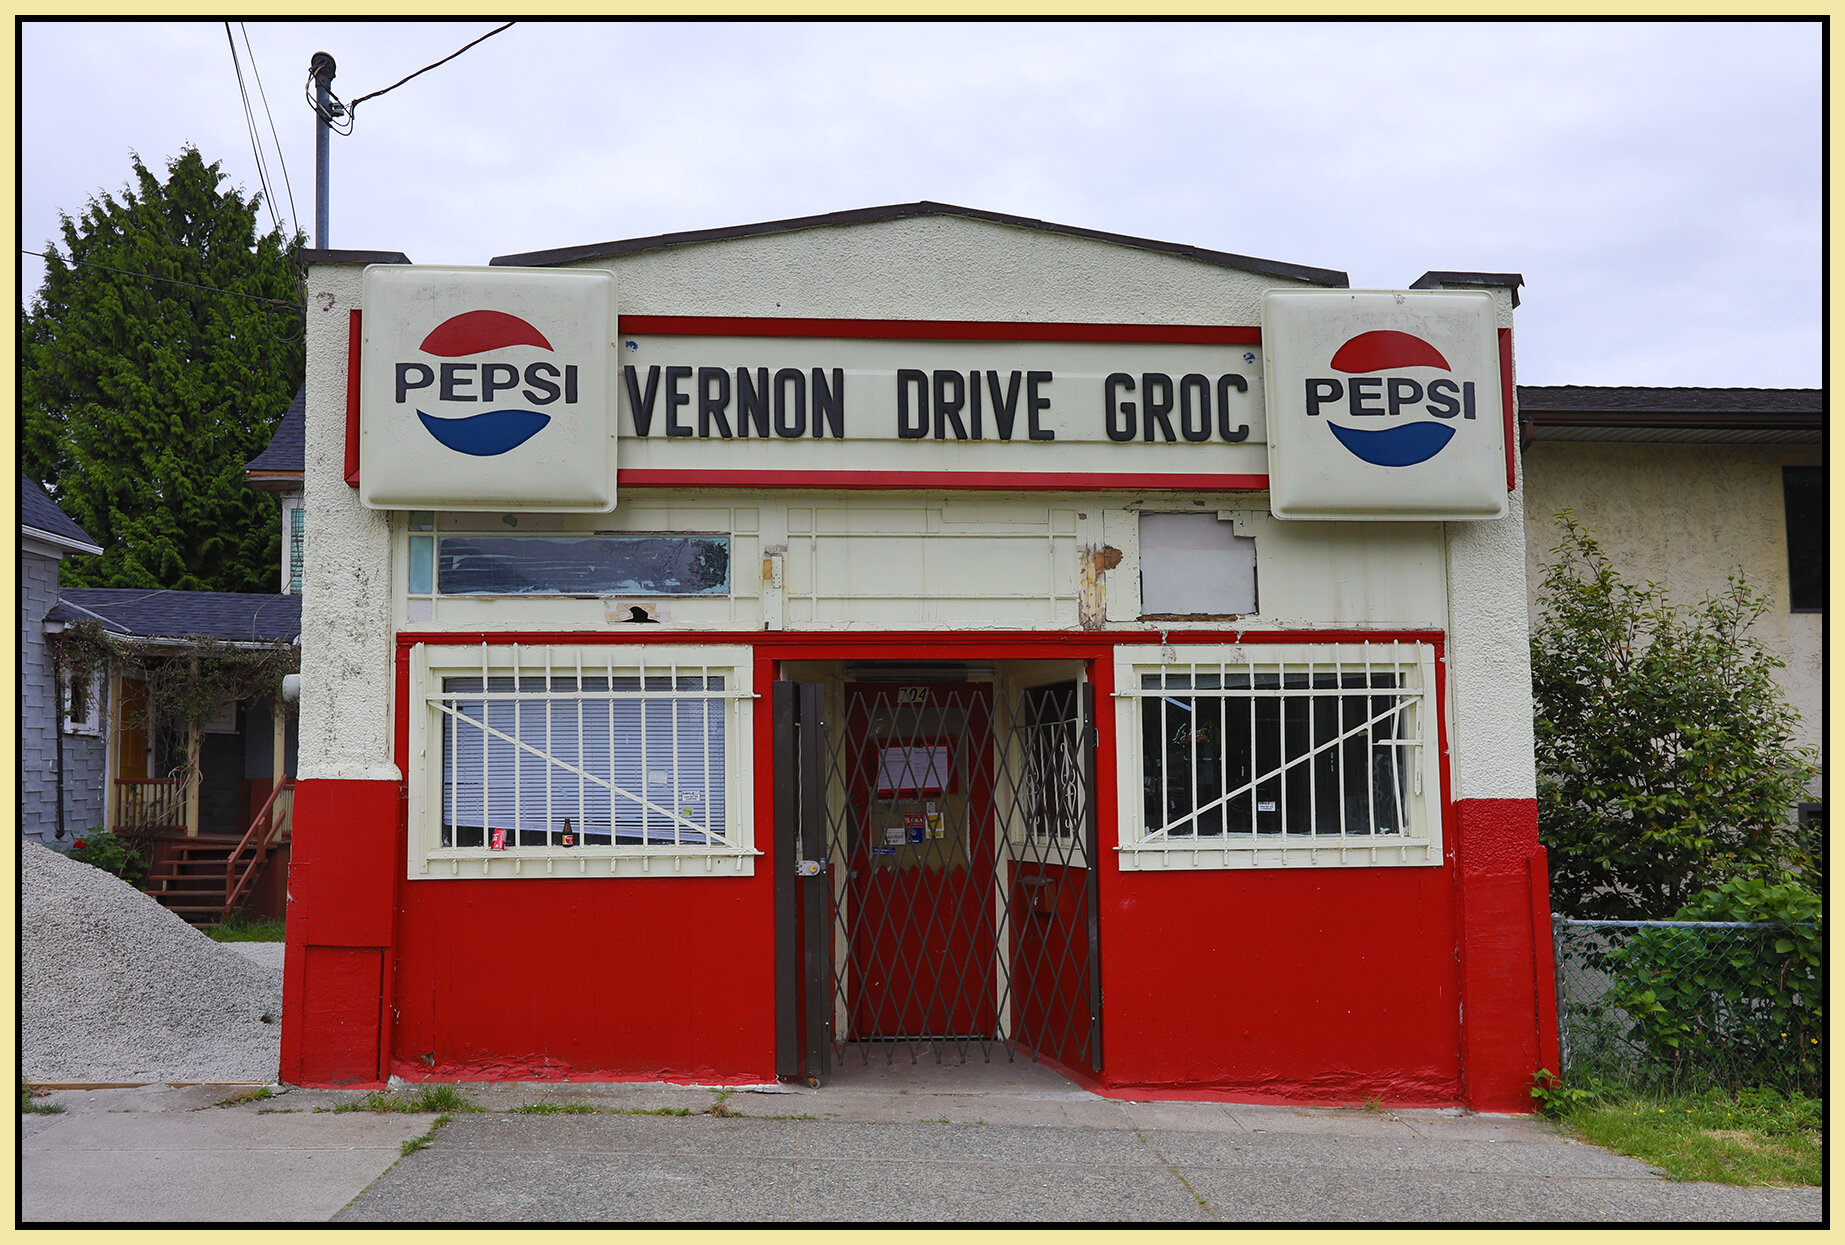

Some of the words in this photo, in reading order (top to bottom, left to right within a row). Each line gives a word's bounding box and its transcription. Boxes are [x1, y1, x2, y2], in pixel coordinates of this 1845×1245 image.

[395, 361, 579, 405] PEPSI
[623, 364, 845, 439] VERNON
[896, 368, 1056, 441] DRIVE
[1104, 372, 1251, 443] GROC
[1304, 376, 1477, 421] PEPSI
